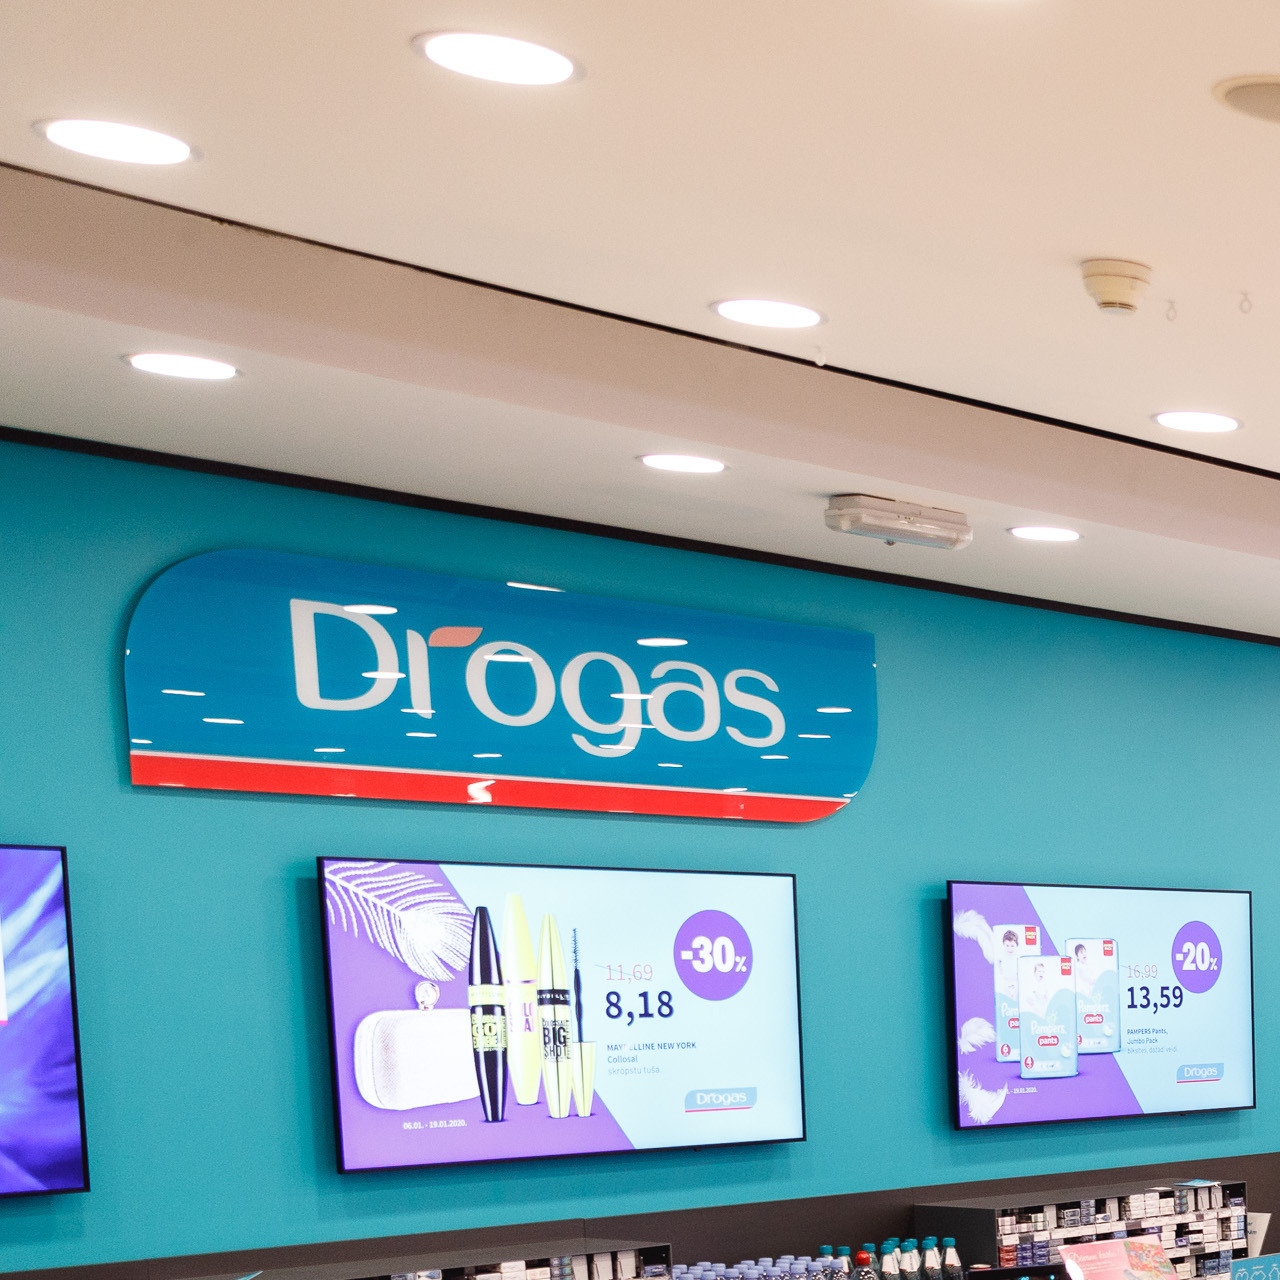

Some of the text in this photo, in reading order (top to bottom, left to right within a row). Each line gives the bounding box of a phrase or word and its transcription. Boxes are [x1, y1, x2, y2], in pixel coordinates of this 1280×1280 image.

[290, 598, 786, 758] Drogas
[681, 936, 747, 973] -30%
[1175, 941, 1218, 971] -20%
[605, 963, 654, 983] 11,69
[1127, 965, 1158, 980] 16,99
[605, 990, 675, 1026] 8,18
[1127, 986, 1184, 1014] 13,59
[606, 1041, 697, 1051] MAYELLINE NEW YORK
[607, 1054, 638, 1064] Collosal
[1184, 1066, 1218, 1078] Drogas
[696, 1090, 747, 1107] Drogas
